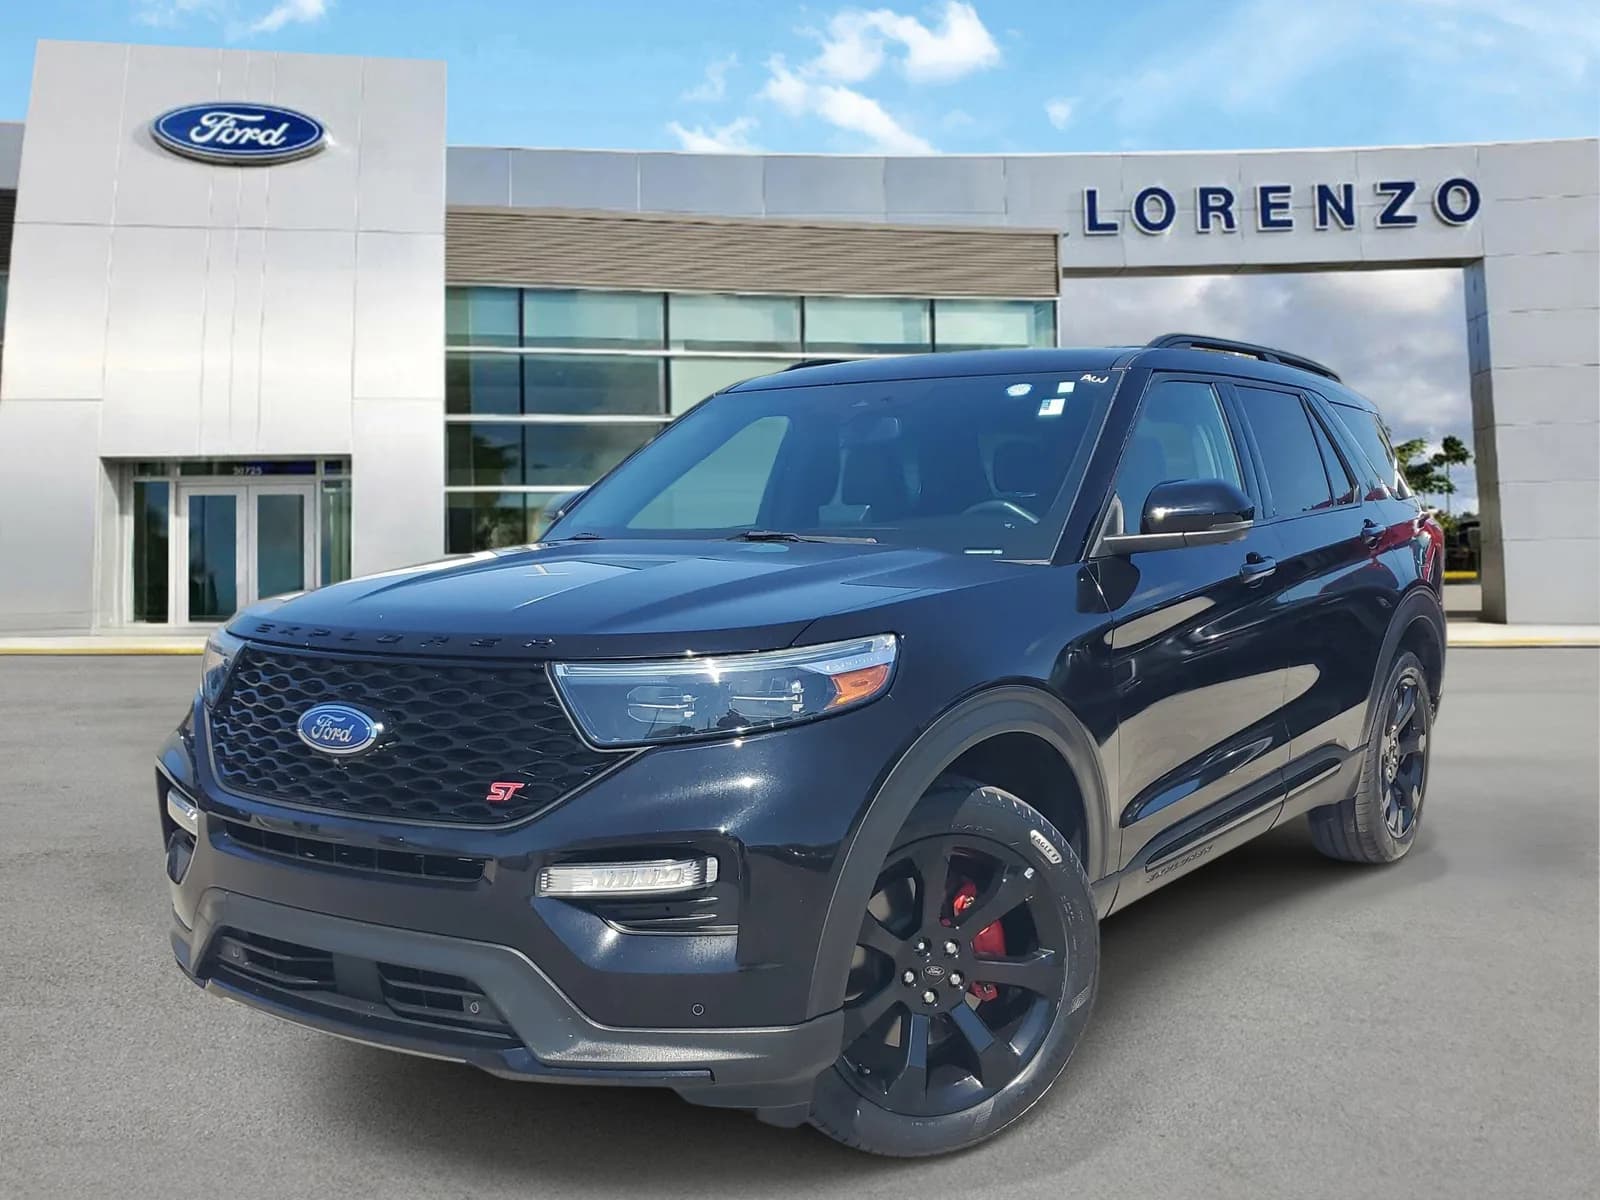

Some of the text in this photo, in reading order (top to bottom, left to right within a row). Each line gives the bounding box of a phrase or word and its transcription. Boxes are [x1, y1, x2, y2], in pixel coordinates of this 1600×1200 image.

[189, 111, 290, 146] Ford
[1083, 177, 1481, 236] LORENZO
[255, 623, 556, 649] EXPLORER
[311, 714, 355, 743] Ford
[486, 782, 525, 801] ST
[1031, 834, 1052, 855] EAGLE
